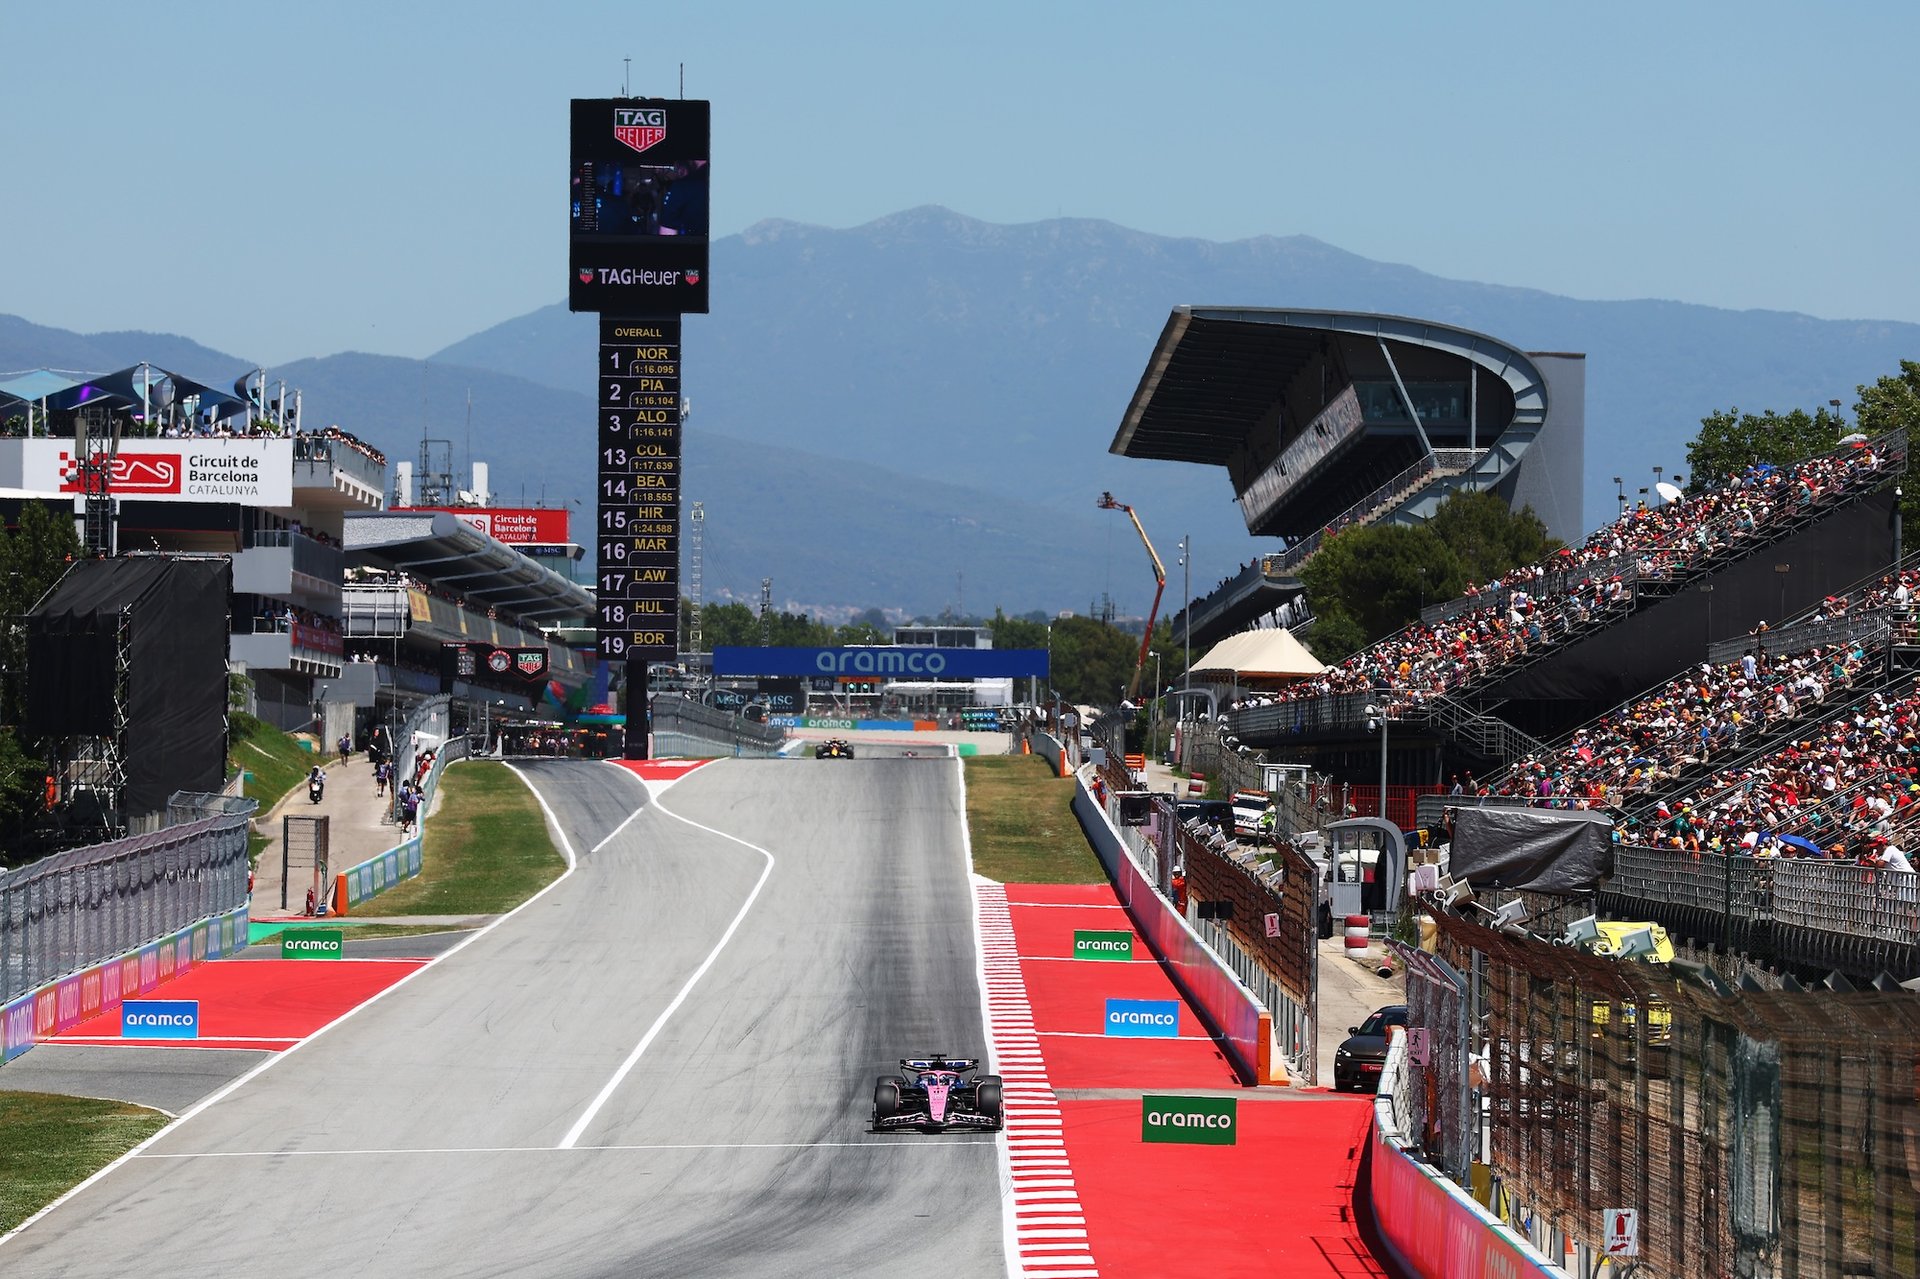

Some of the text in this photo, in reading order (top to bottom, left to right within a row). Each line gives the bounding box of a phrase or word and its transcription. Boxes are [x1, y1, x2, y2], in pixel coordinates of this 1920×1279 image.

[619, 112, 661, 125] TAG
[618, 129, 662, 149] HEUER
[615, 328, 662, 337] OVERALL
[611, 348, 668, 368] 1 NOR
[635, 365, 673, 373] 1:16.095
[610, 379, 664, 400] 2 PIA
[610, 411, 666, 431] 3 ALO
[635, 428, 672, 436] 1:16.141
[189, 454, 259, 468] Circuit de
[604, 445, 666, 465] 13 COL
[635, 462, 673, 470] 1:17.639
[189, 470, 258, 482] Barcelona
[188, 485, 258, 495] CATALUNYA
[604, 476, 666, 496] 14 BEA
[634, 493, 672, 501] 1:18.555
[495, 514, 537, 524] Circuit de
[604, 507, 663, 528] 15 HIR
[495, 524, 537, 533] Barcelona
[634, 524, 672, 533] 1:24.588
[603, 539, 666, 559] 16 MAR
[602, 570, 666, 590] 17 LAW
[602, 601, 664, 622] 18 HUL
[602, 633, 664, 653] 19 BOR
[816, 652, 945, 673] aramco
[815, 679, 830, 688] FIA
[808, 718, 852, 729] aramco
[285, 940, 338, 951] aramco
[1077, 941, 1129, 950] aramco
[127, 1014, 193, 1026] aramco
[1110, 1012, 1174, 1025] aramco
[9, 1003, 34, 1050] aramco
[1148, 1112, 1231, 1128] aramco
